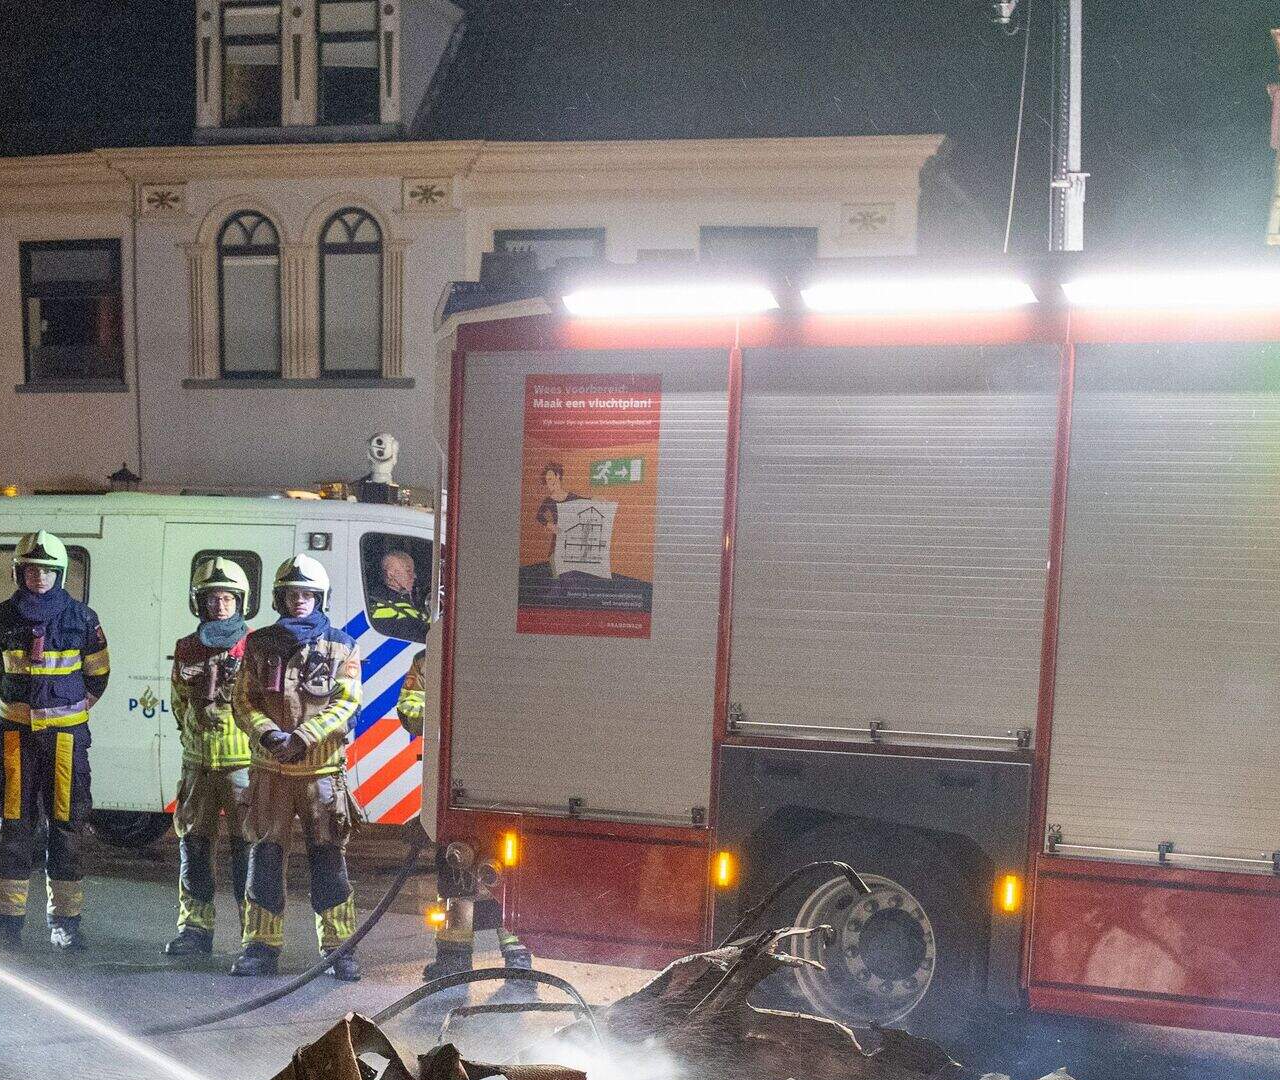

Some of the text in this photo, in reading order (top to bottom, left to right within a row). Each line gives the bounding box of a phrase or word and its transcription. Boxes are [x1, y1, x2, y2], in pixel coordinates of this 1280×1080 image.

[533, 385, 562, 395] Wees
[532, 398, 652, 410] Maak een vluchtplan!
[1048, 823, 1062, 833] K2
